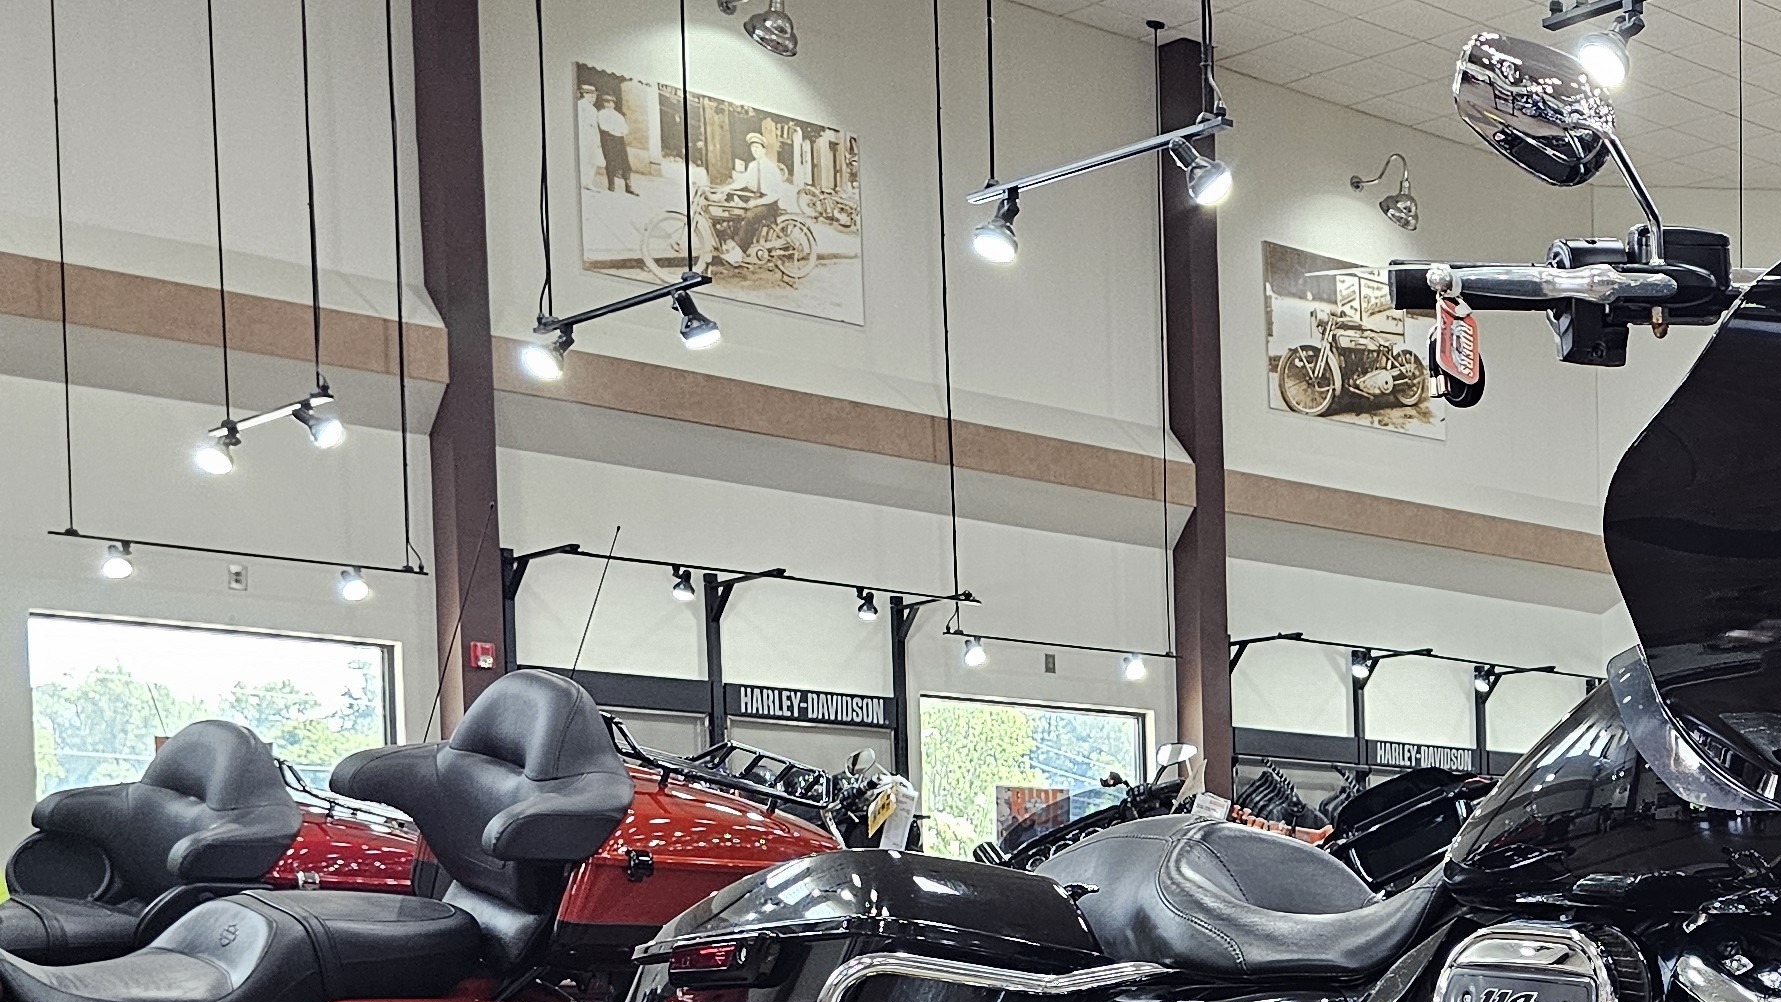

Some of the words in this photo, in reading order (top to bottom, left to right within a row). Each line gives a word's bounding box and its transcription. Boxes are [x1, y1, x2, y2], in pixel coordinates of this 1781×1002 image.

[1456, 319, 1474, 377] RIDERS
[740, 686, 885, 725] HARLEY-DAVIDSON
[1377, 741, 1472, 771] HARLEY-DAVIDSON
